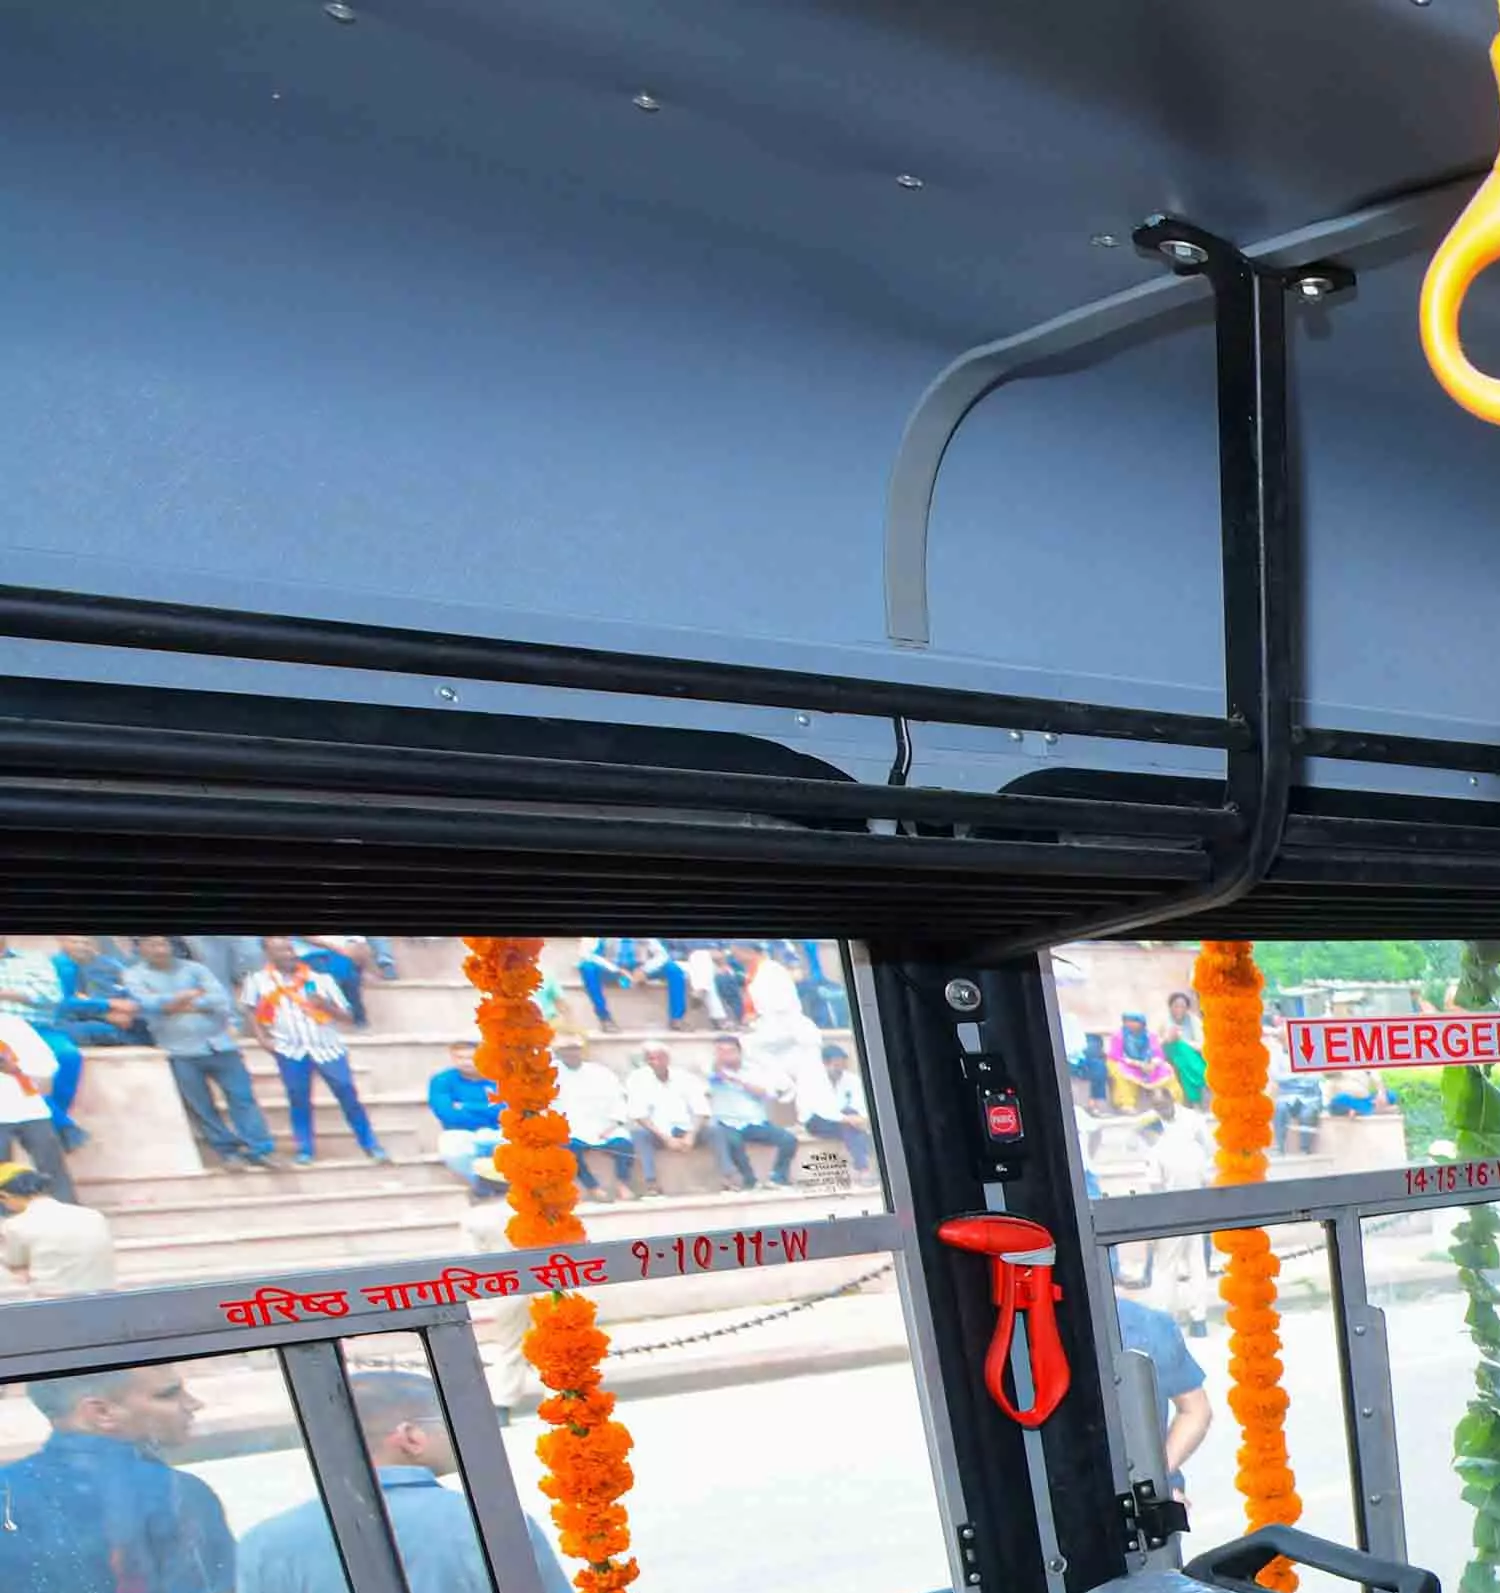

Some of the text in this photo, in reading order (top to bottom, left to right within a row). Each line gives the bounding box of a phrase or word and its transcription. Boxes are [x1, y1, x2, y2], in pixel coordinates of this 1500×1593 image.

[219, 1287, 348, 1328] वरिष्ठ
[361, 1267, 519, 1311] नागरिक
[530, 1253, 609, 1290] सीट
